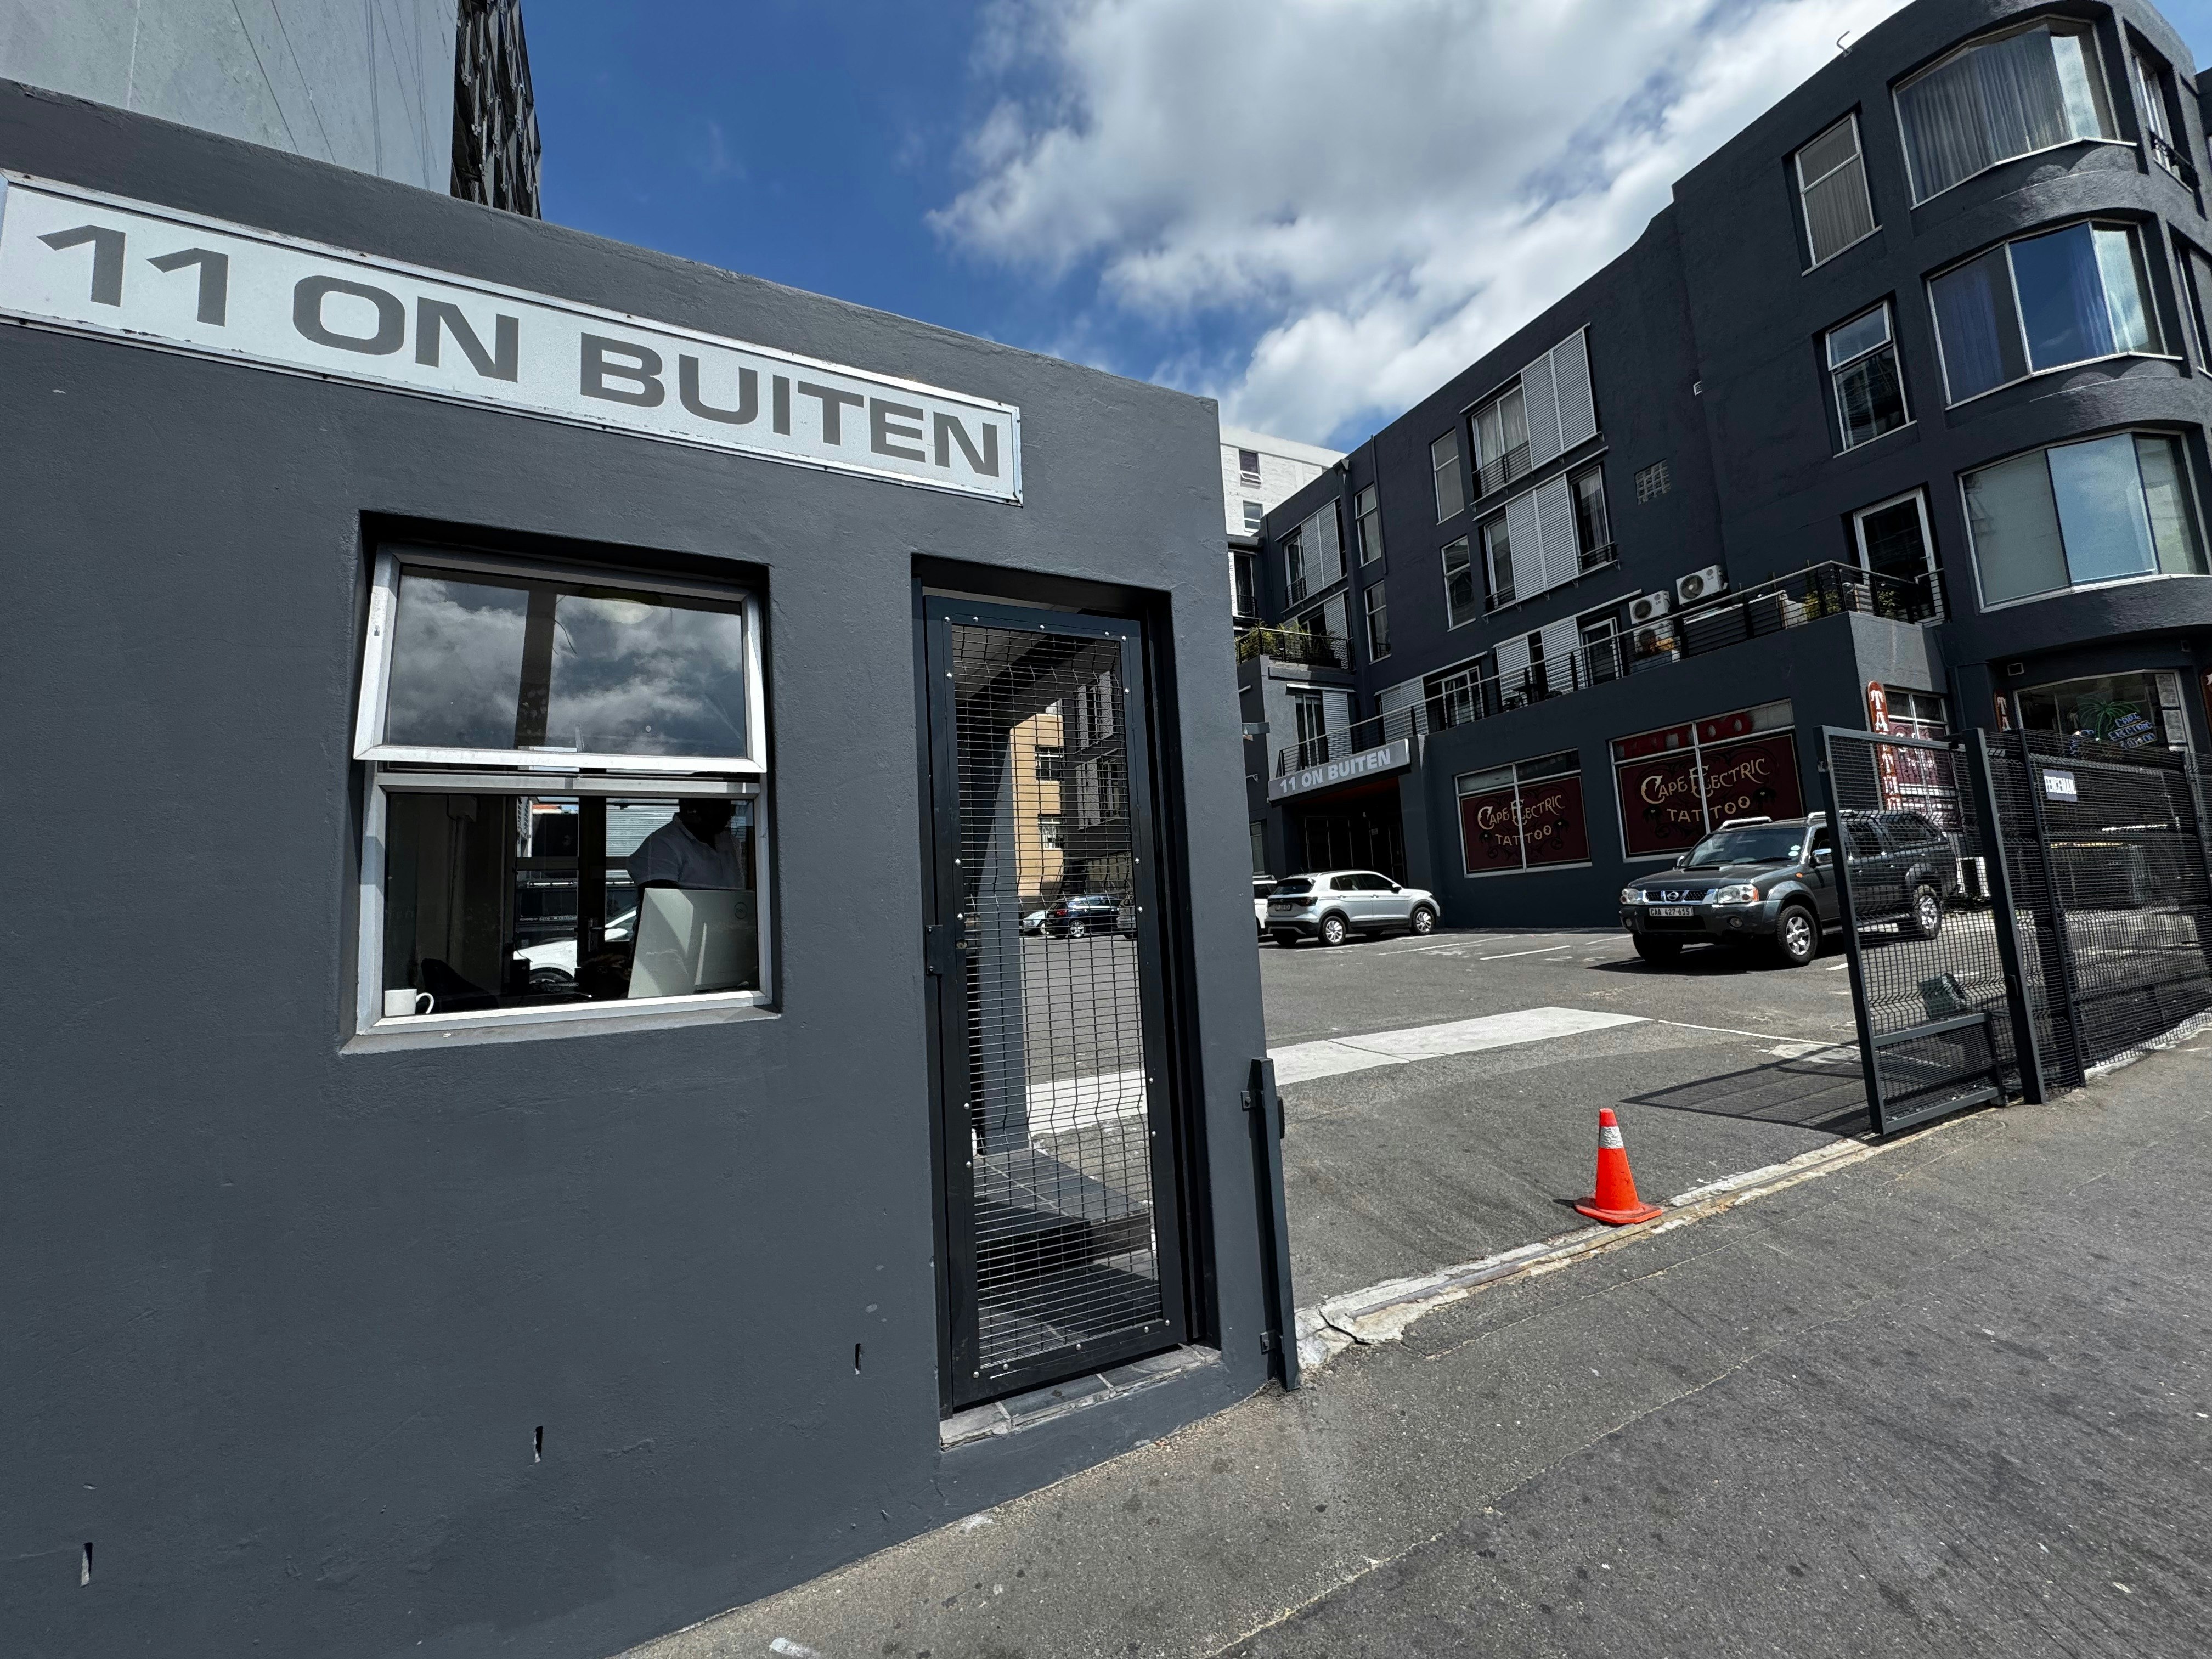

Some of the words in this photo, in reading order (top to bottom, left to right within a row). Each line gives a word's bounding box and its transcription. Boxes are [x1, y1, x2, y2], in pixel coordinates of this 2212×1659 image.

[36, 224, 228, 328] 11
[292, 275, 520, 383] ON
[580, 333, 1000, 477] BUITEN
[1280, 776, 1296, 793] 11
[1301, 769, 1323, 787] ON
[1328, 748, 1391, 781] BUITEN
[1641, 775, 1688, 804] CAPE
[1477, 806, 1510, 830] CAPE
[1666, 796, 1750, 822] TATTOO
[1495, 825, 1552, 846] TATTOO
